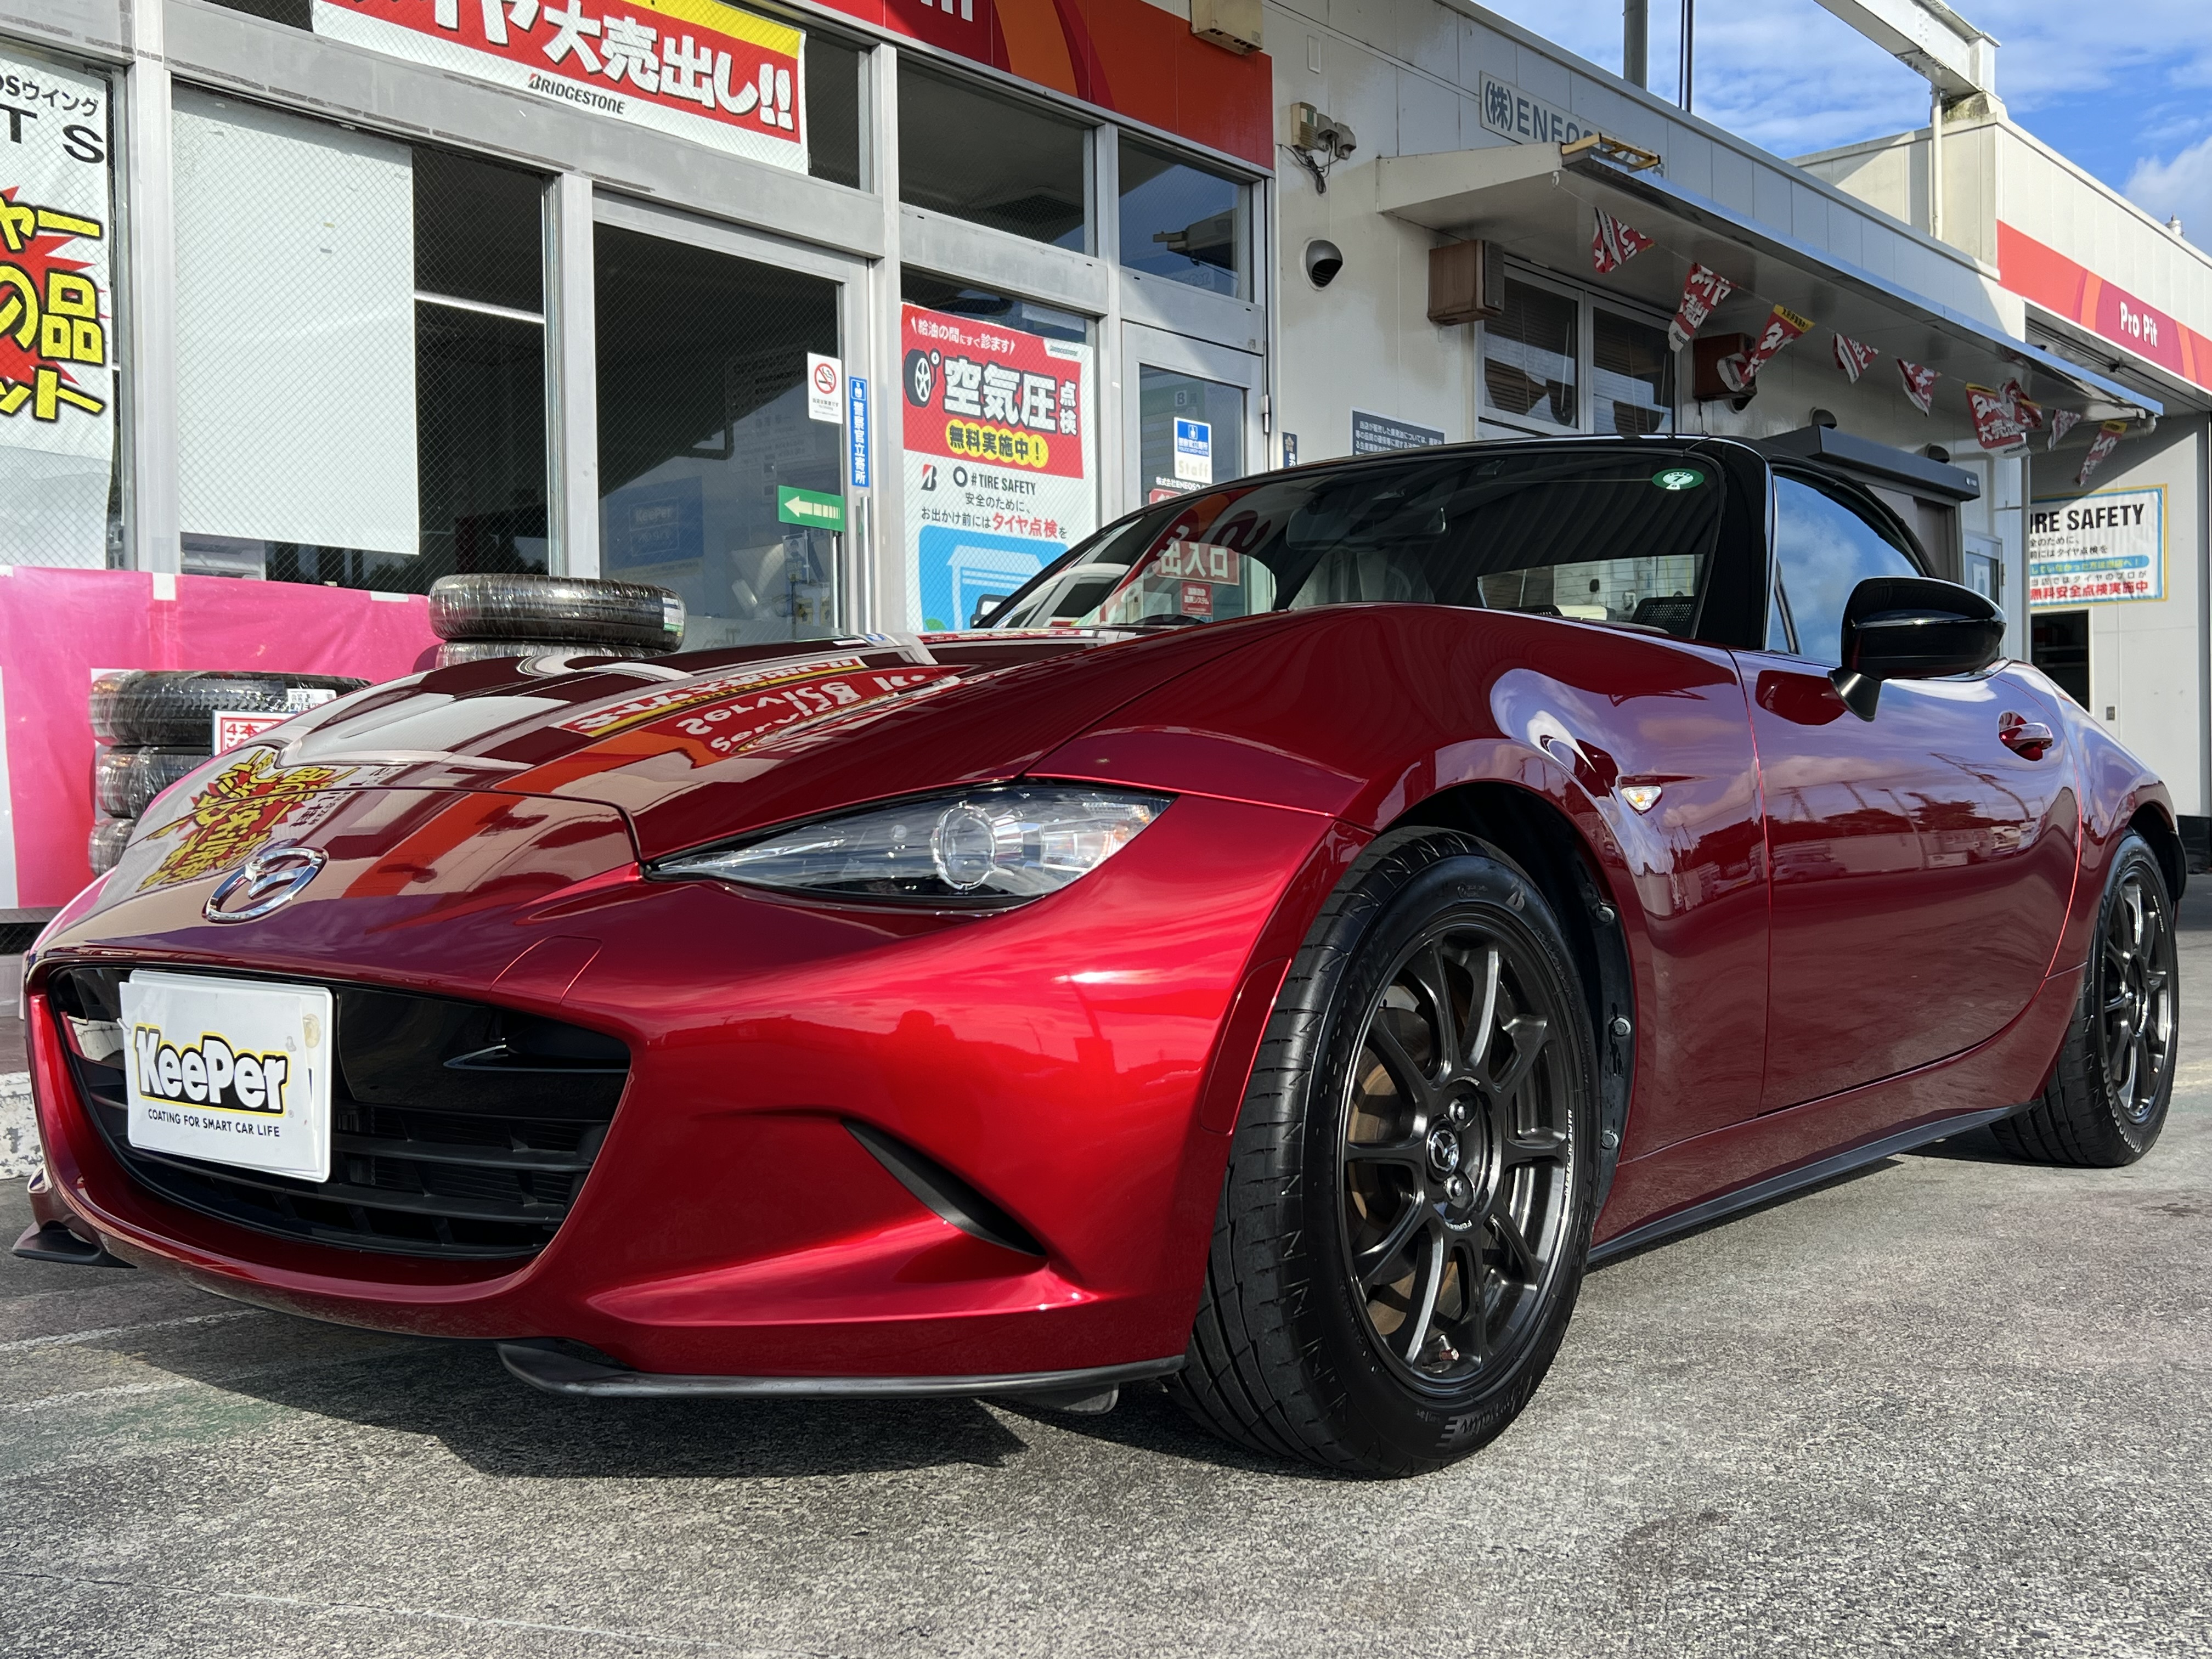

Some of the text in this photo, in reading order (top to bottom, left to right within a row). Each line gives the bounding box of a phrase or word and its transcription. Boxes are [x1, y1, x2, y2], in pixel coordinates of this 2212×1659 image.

[528, 73, 625, 115] BRIDGESTONE
[918, 319, 1009, 353] 給油の間にすぐ診ます
[2120, 301, 2158, 348] Pro Pit
[944, 356, 1057, 433] 空気圧
[1059, 380, 1077, 436] 点検
[853, 400, 866, 485] 警察官立寄所
[949, 425, 1040, 461] 無料実施中!
[1001, 477, 1036, 495] SAFETY
[1178, 460, 1209, 478] Staff
[965, 492, 1031, 514] 安全のために、
[2067, 504, 2145, 531] SAFETY
[921, 506, 1068, 539] お出かけ前にはタイヤ点検を
[1161, 544, 1229, 579] 出入口
[2031, 571, 2147, 586] 当店ではタイヤのプロが
[2030, 580, 2148, 600] 無料安全点検実施中
[136, 1026, 288, 1114] KeePer
[148, 1108, 281, 1138] COATING FOR SMART CAR LIFE
